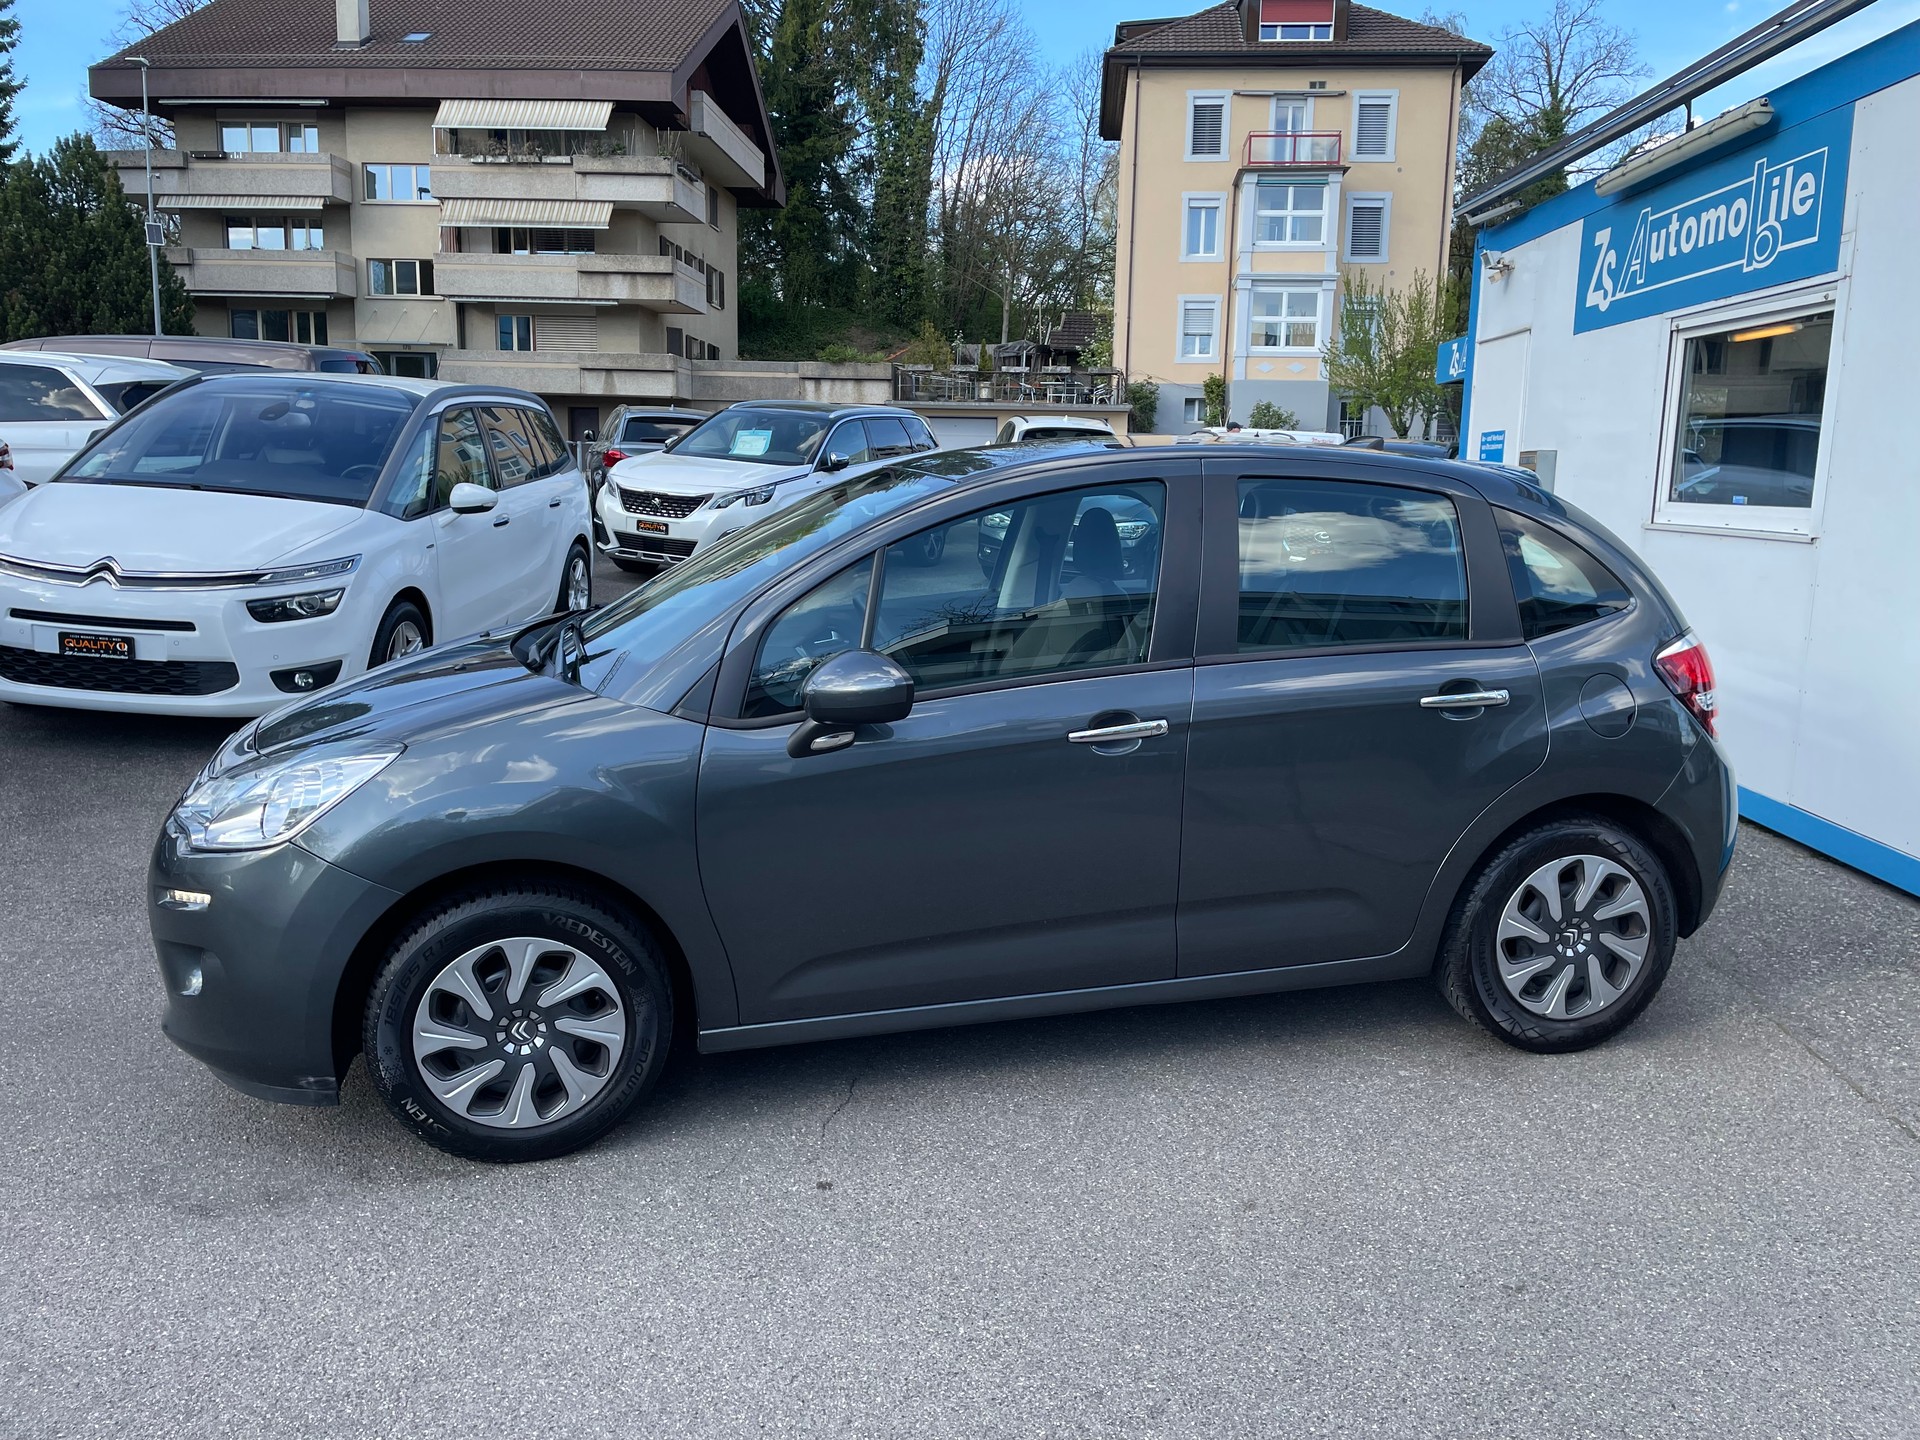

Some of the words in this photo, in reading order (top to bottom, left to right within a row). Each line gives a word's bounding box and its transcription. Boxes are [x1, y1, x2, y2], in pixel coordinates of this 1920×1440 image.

[1616, 157, 1816, 299] Automobile
[64, 638, 116, 650] QUALITY
[542, 912, 637, 976] VREDESTEIN
